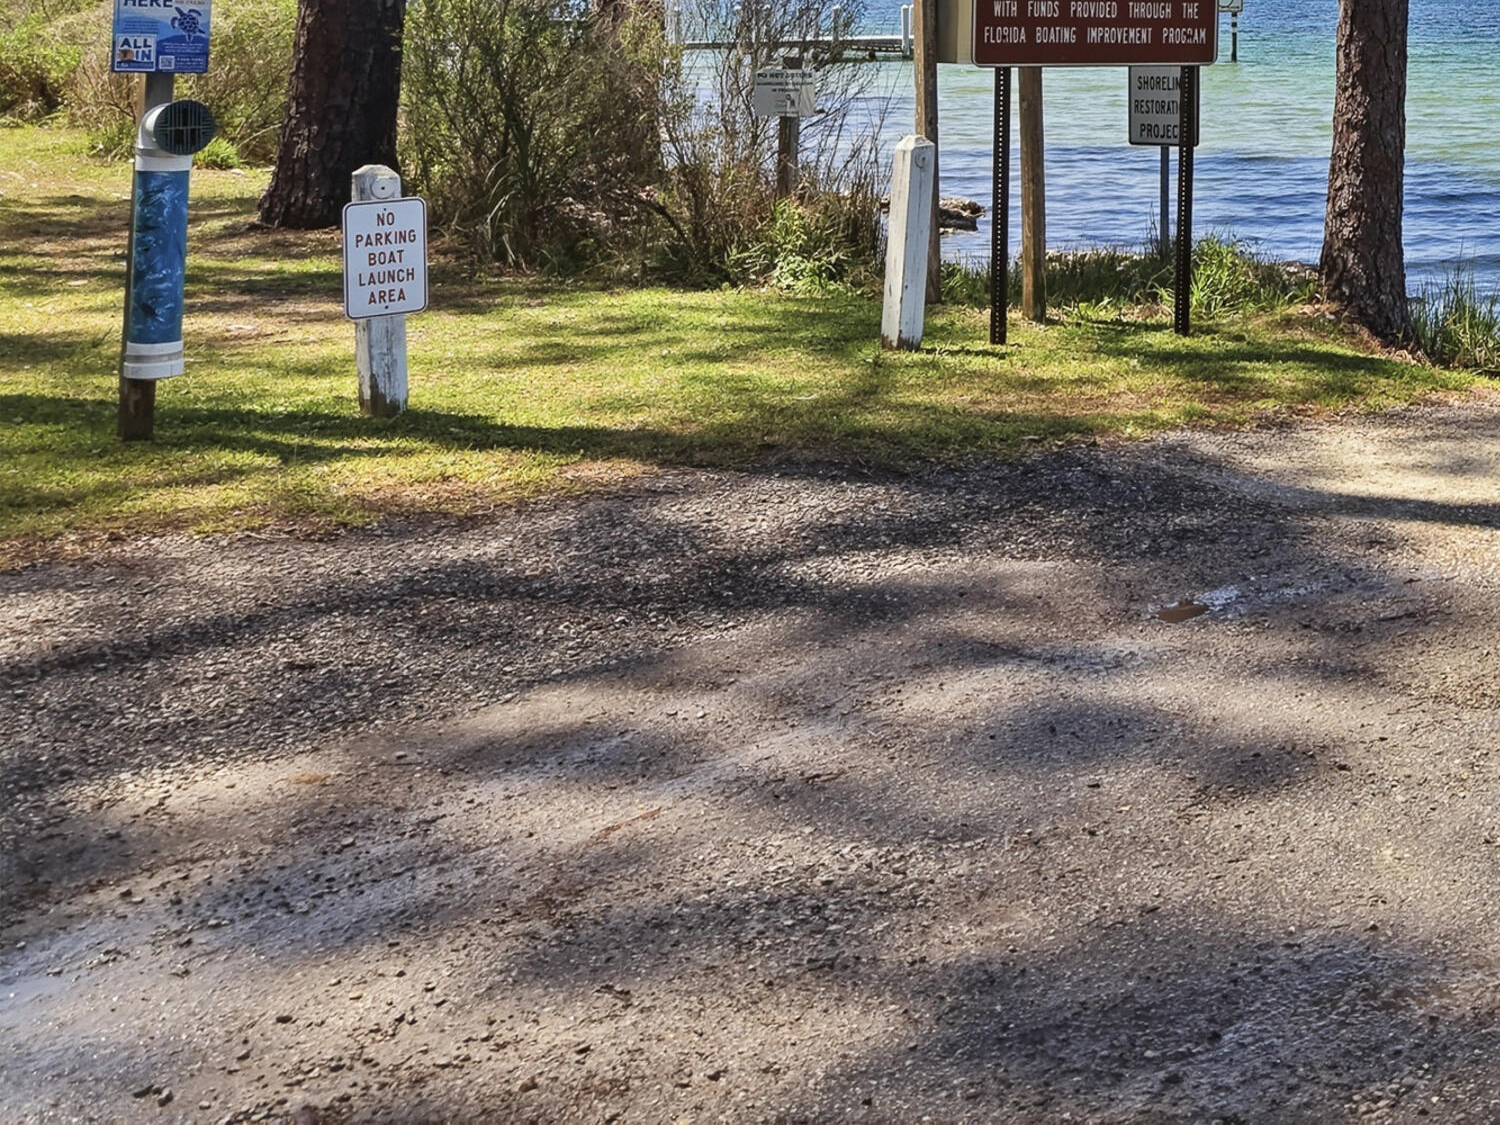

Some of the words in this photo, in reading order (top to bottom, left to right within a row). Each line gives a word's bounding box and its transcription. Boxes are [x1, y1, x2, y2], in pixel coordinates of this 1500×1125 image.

[993, 0, 1018, 17] WITH
[1027, 0, 1060, 18] FUNDS
[1070, 1, 1118, 18] PROVIDED
[1128, 1, 1172, 19] THROUGH
[1182, 2, 1199, 19] THE
[120, 37, 152, 49] ALL
[984, 26, 1026, 44] FLORIDA
[1035, 26, 1077, 44] BOATING
[1087, 27, 1152, 44] IMPROVEMENT
[1162, 27, 1206, 44] PROGRAM
[135, 49, 152, 61] IN
[1137, 75, 1181, 91] SHORELIN
[1134, 99, 1180, 115] RESTORATI
[1140, 123, 1179, 139] PROJEC
[376, 212, 395, 227] NO
[355, 229, 417, 249] PARKING
[368, 249, 405, 267] BOAT
[358, 267, 415, 287] LAUNCH
[368, 287, 406, 305] AREA
